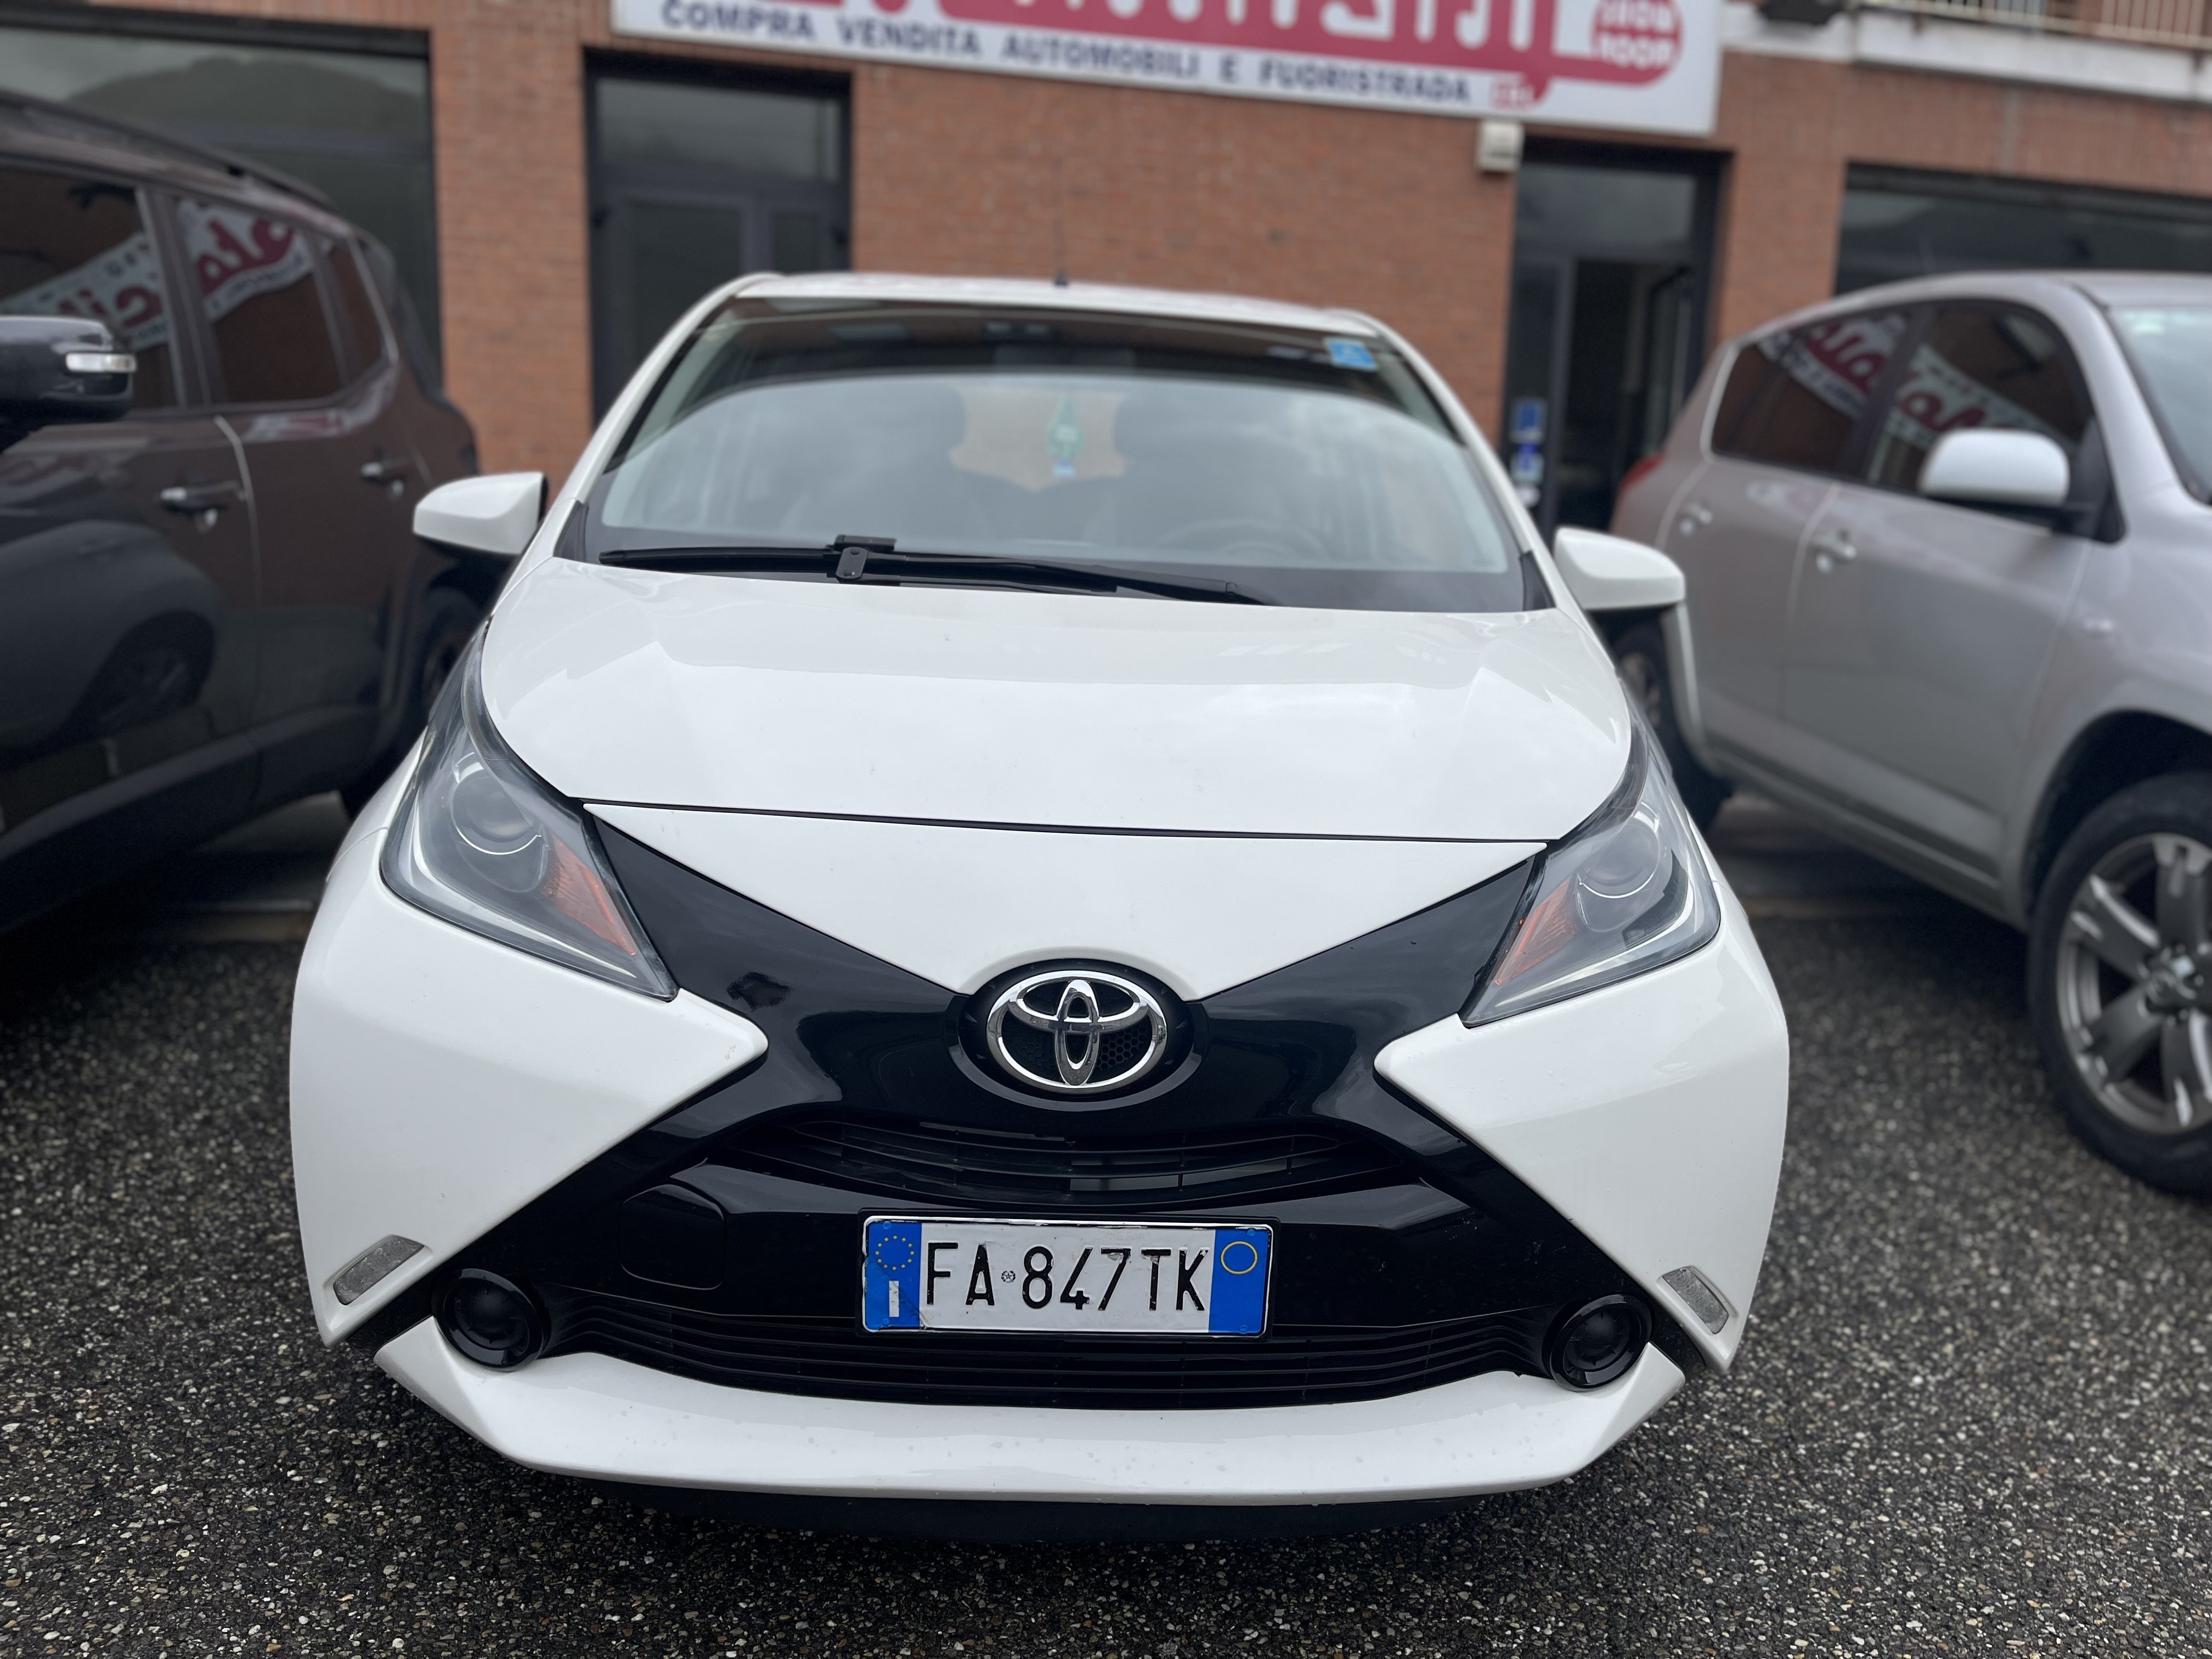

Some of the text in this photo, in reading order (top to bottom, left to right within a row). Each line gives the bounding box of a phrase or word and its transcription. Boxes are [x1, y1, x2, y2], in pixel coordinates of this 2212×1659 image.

[662, 0, 816, 40] COMPRA
[836, 15, 982, 57] VENDITA
[1001, 33, 1201, 78] AUTOMOBILI
[1219, 55, 1240, 83] E
[1259, 58, 1471, 104] FUORISTRADA
